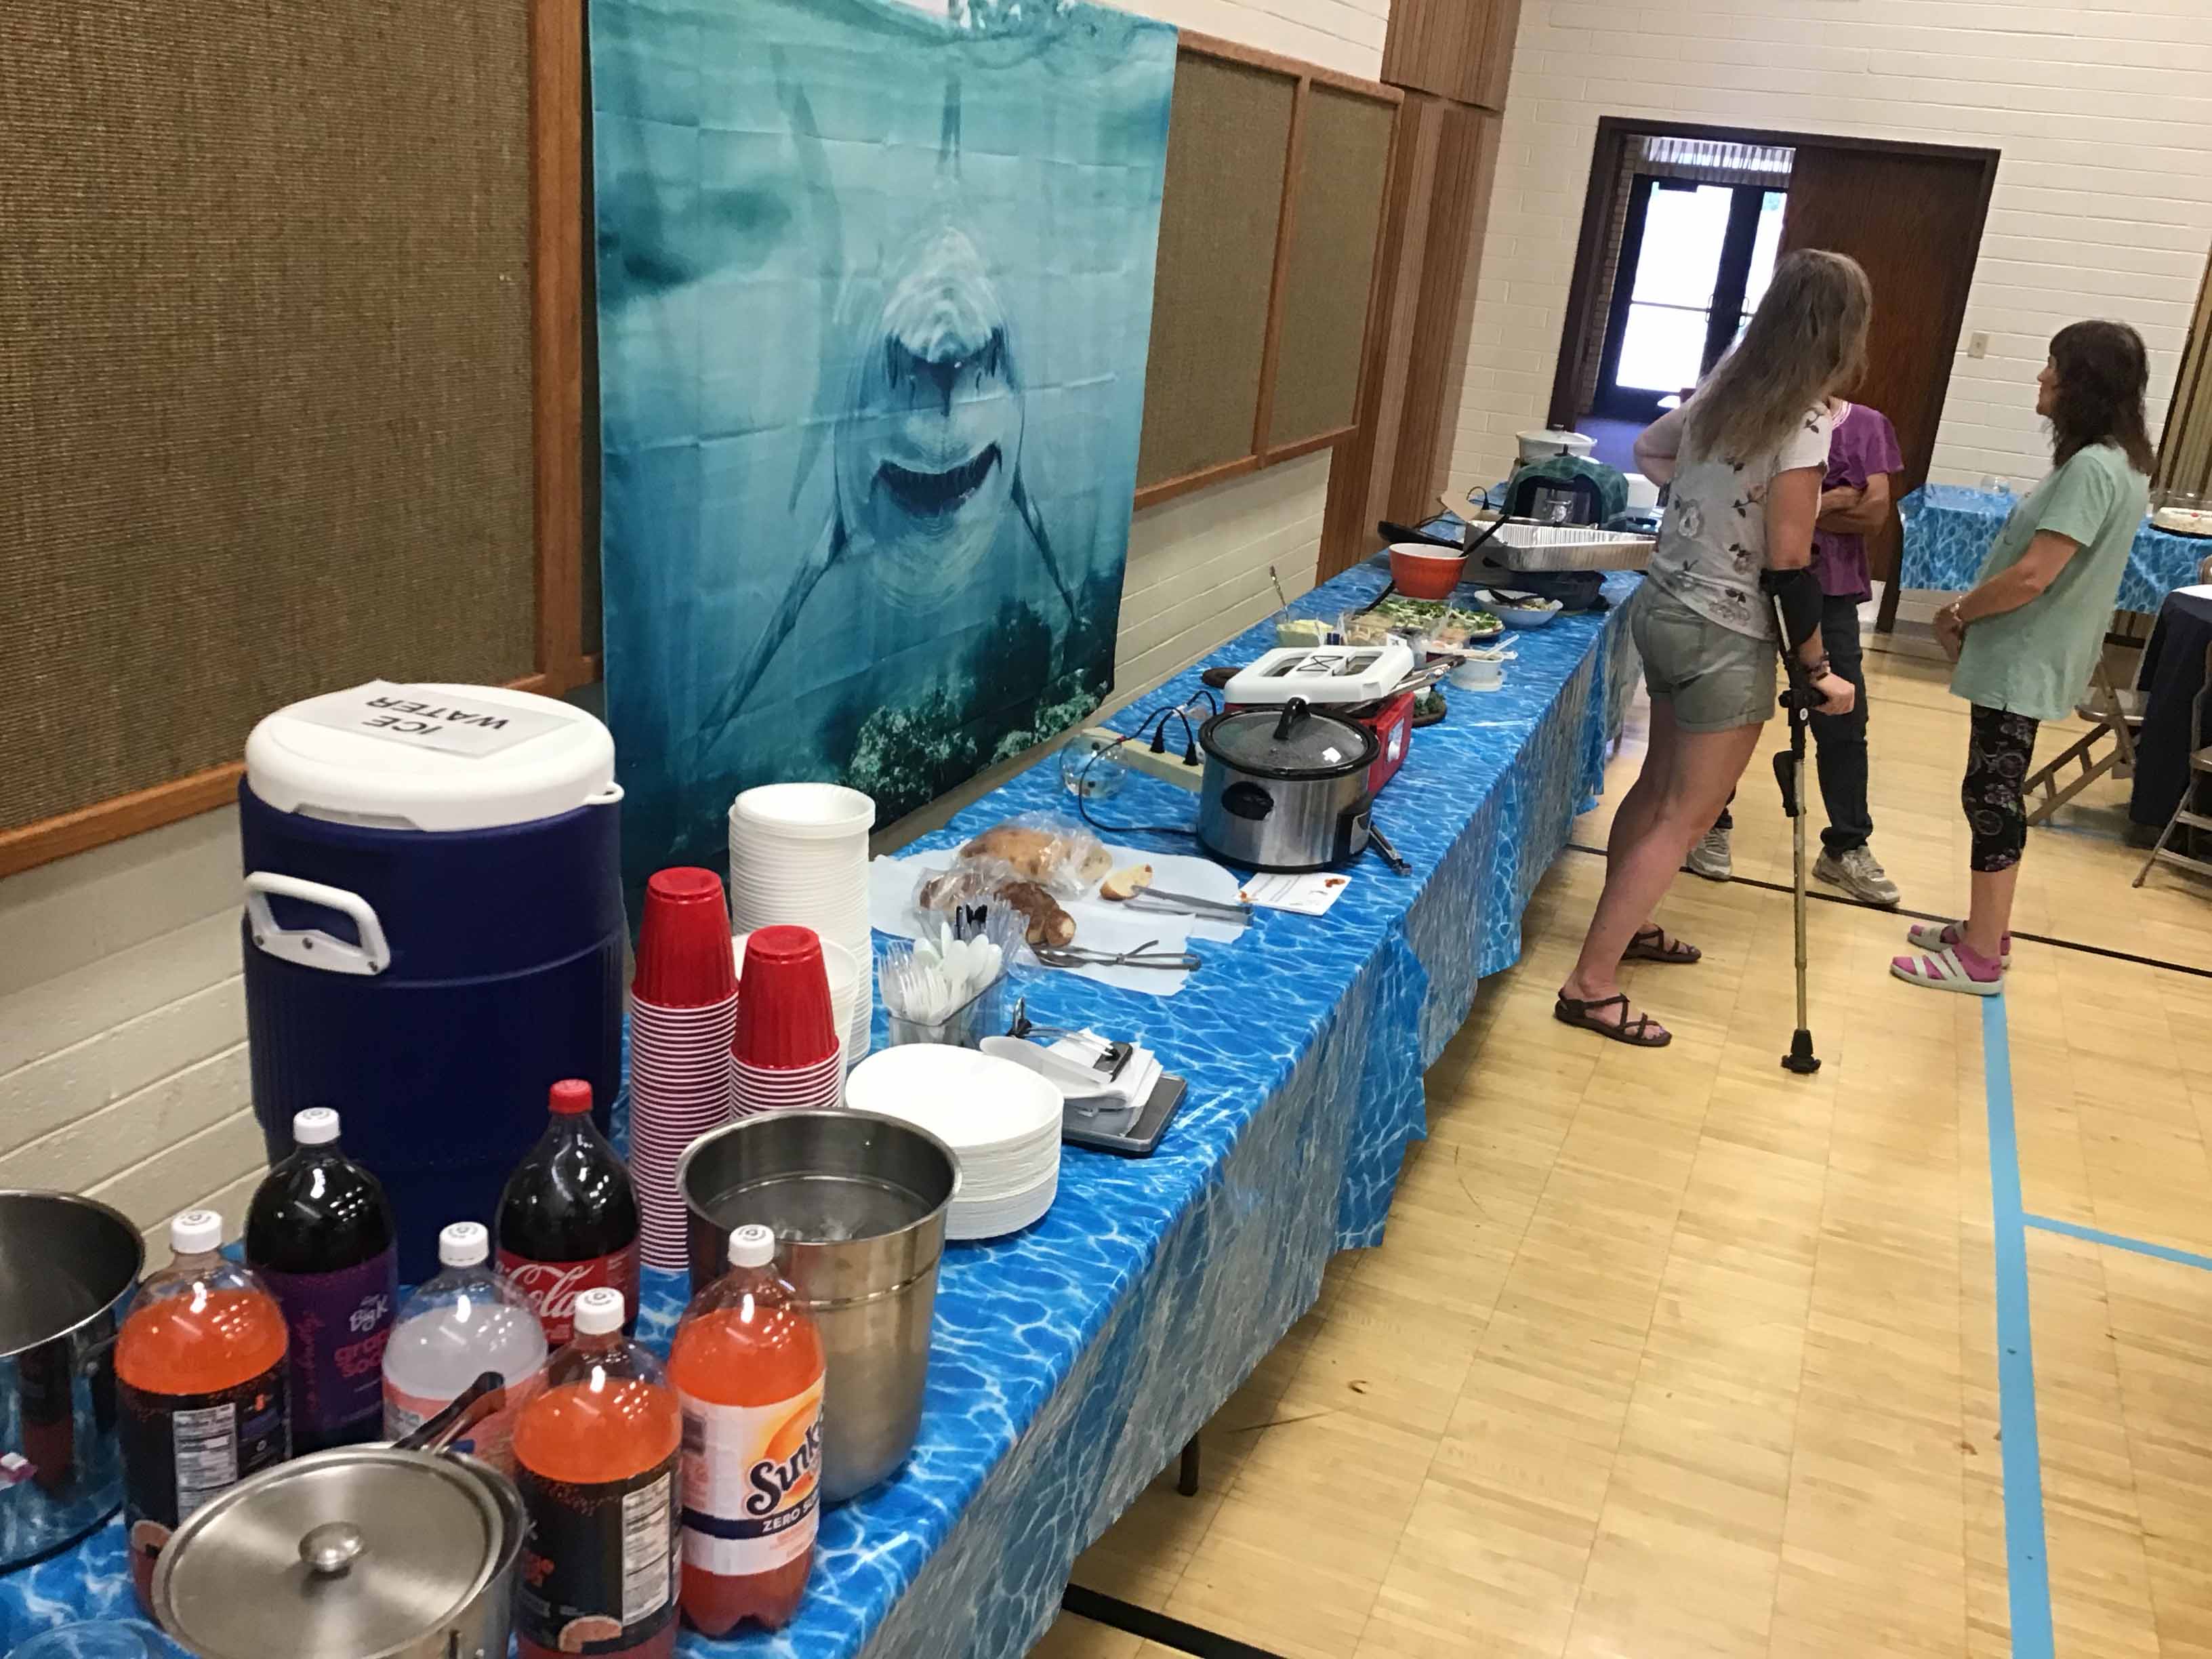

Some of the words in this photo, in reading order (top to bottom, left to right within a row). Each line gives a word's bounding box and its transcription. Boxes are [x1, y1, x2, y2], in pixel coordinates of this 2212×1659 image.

[361, 714, 443, 735] ICE
[365, 697, 510, 730] WATER
[762, 1509, 800, 1533] ZERO
